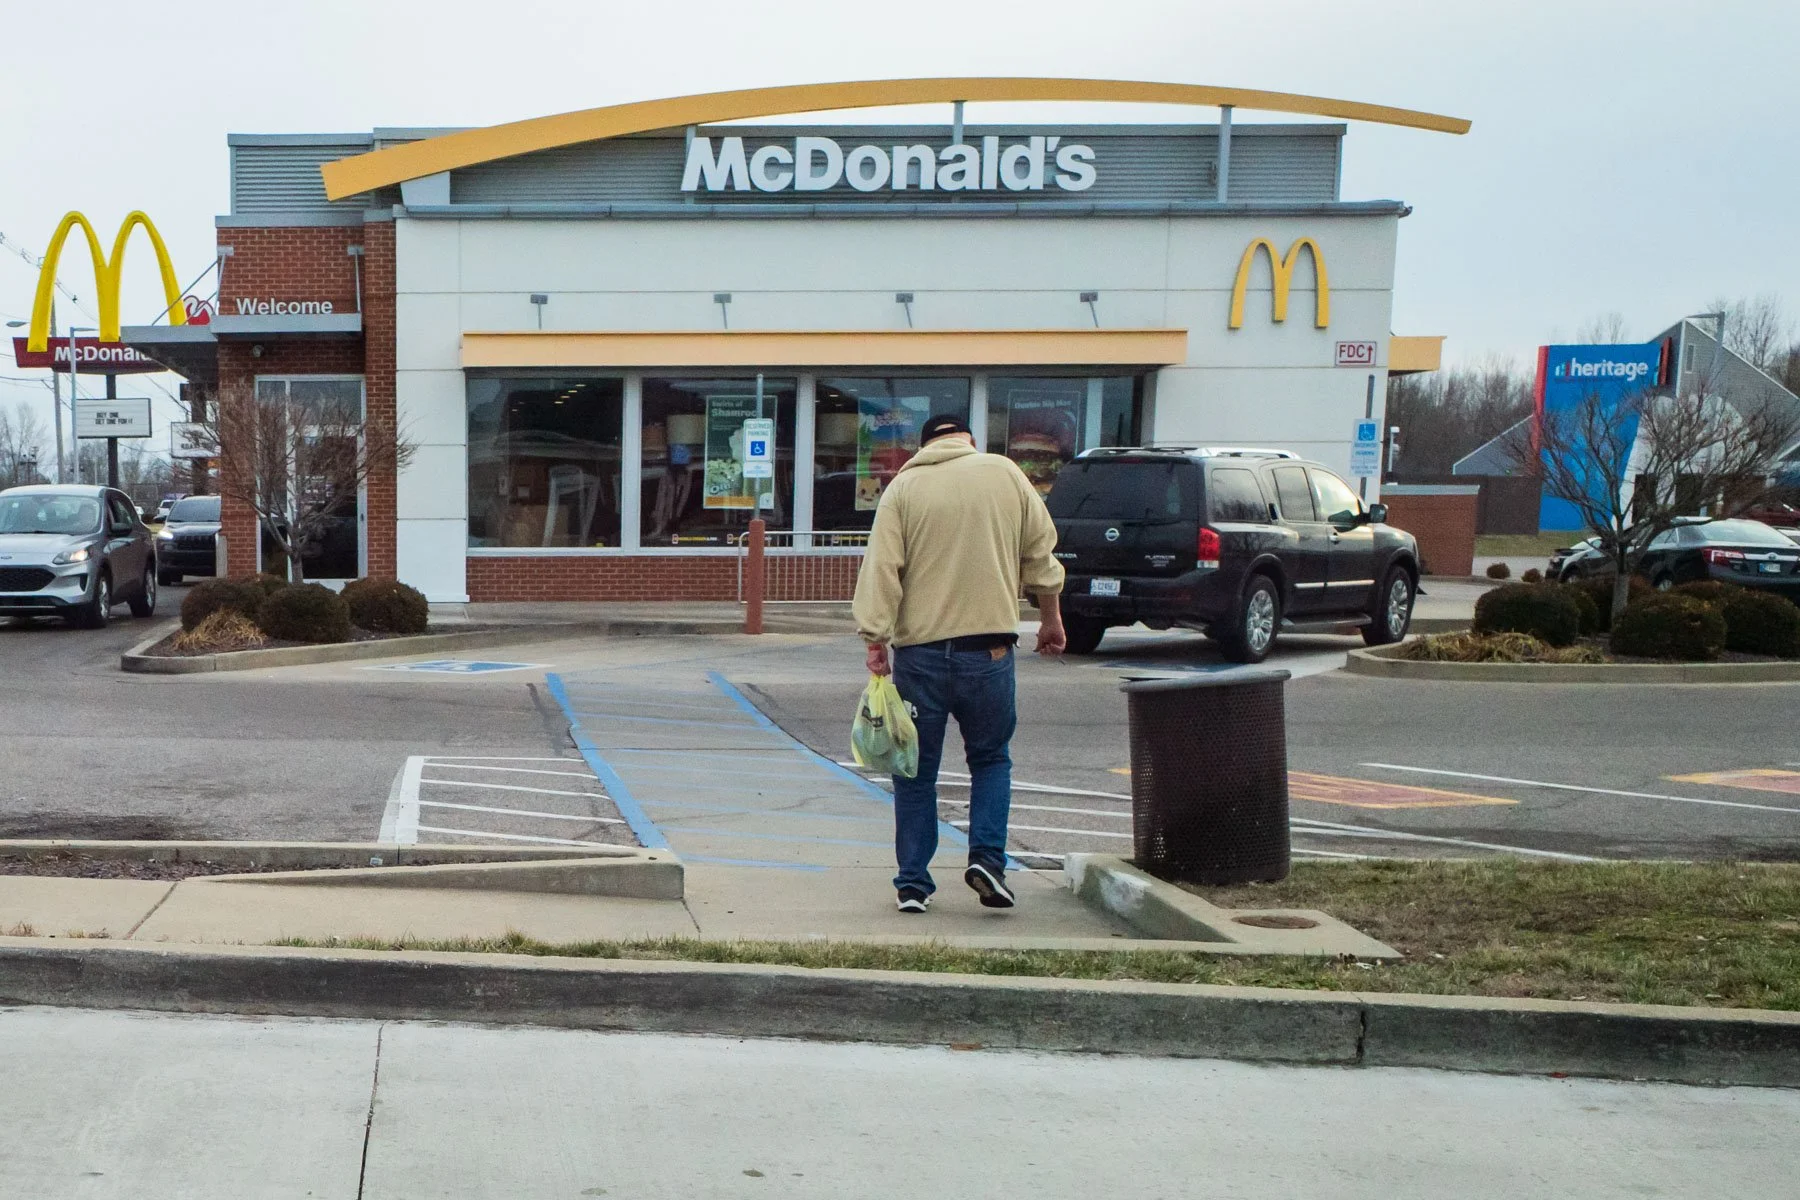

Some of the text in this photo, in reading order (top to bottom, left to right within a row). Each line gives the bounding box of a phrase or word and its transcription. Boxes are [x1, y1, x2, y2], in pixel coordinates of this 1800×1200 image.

[681, 136, 1097, 192] McDonald's
[236, 298, 333, 314] Welcome
[1339, 344, 1365, 358] FDC
[1571, 357, 1649, 381] heritage
